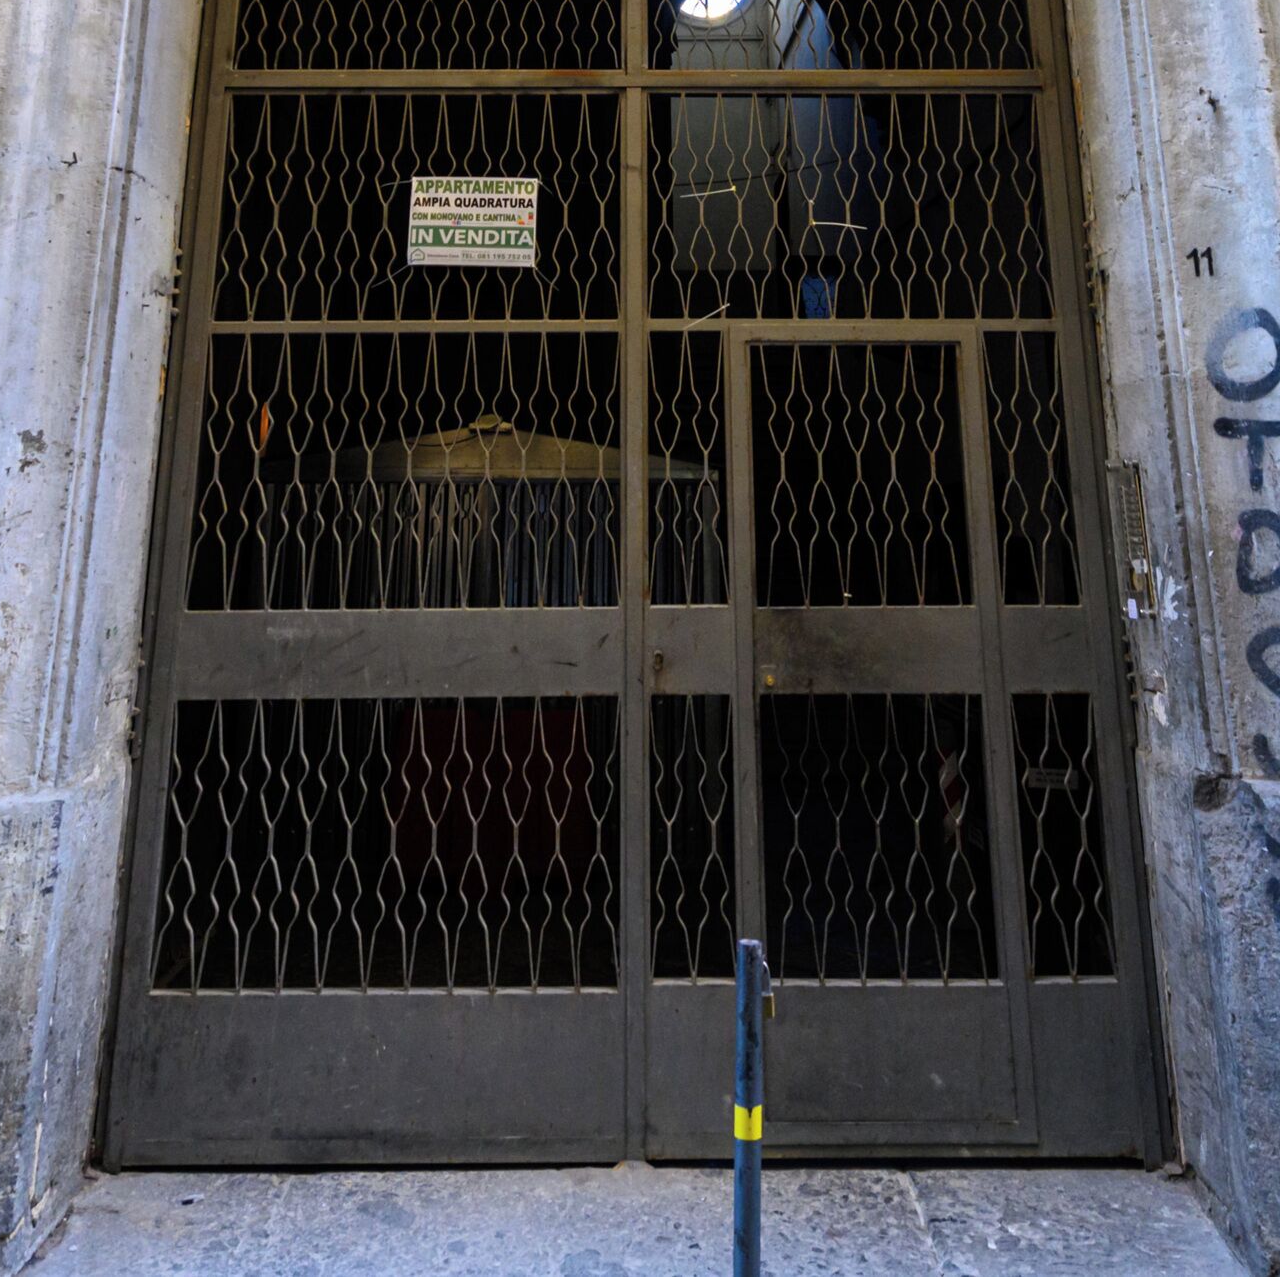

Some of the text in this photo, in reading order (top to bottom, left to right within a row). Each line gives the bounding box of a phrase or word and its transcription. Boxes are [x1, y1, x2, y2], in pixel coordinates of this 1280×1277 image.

[414, 179, 535, 195] APPARTAMENTO
[413, 197, 534, 209] AMPIA QUADRATURA
[411, 212, 516, 222] CON MONOVANO E CANTINA
[411, 228, 534, 245] IN VENDITA
[1186, 247, 1214, 276] 11
